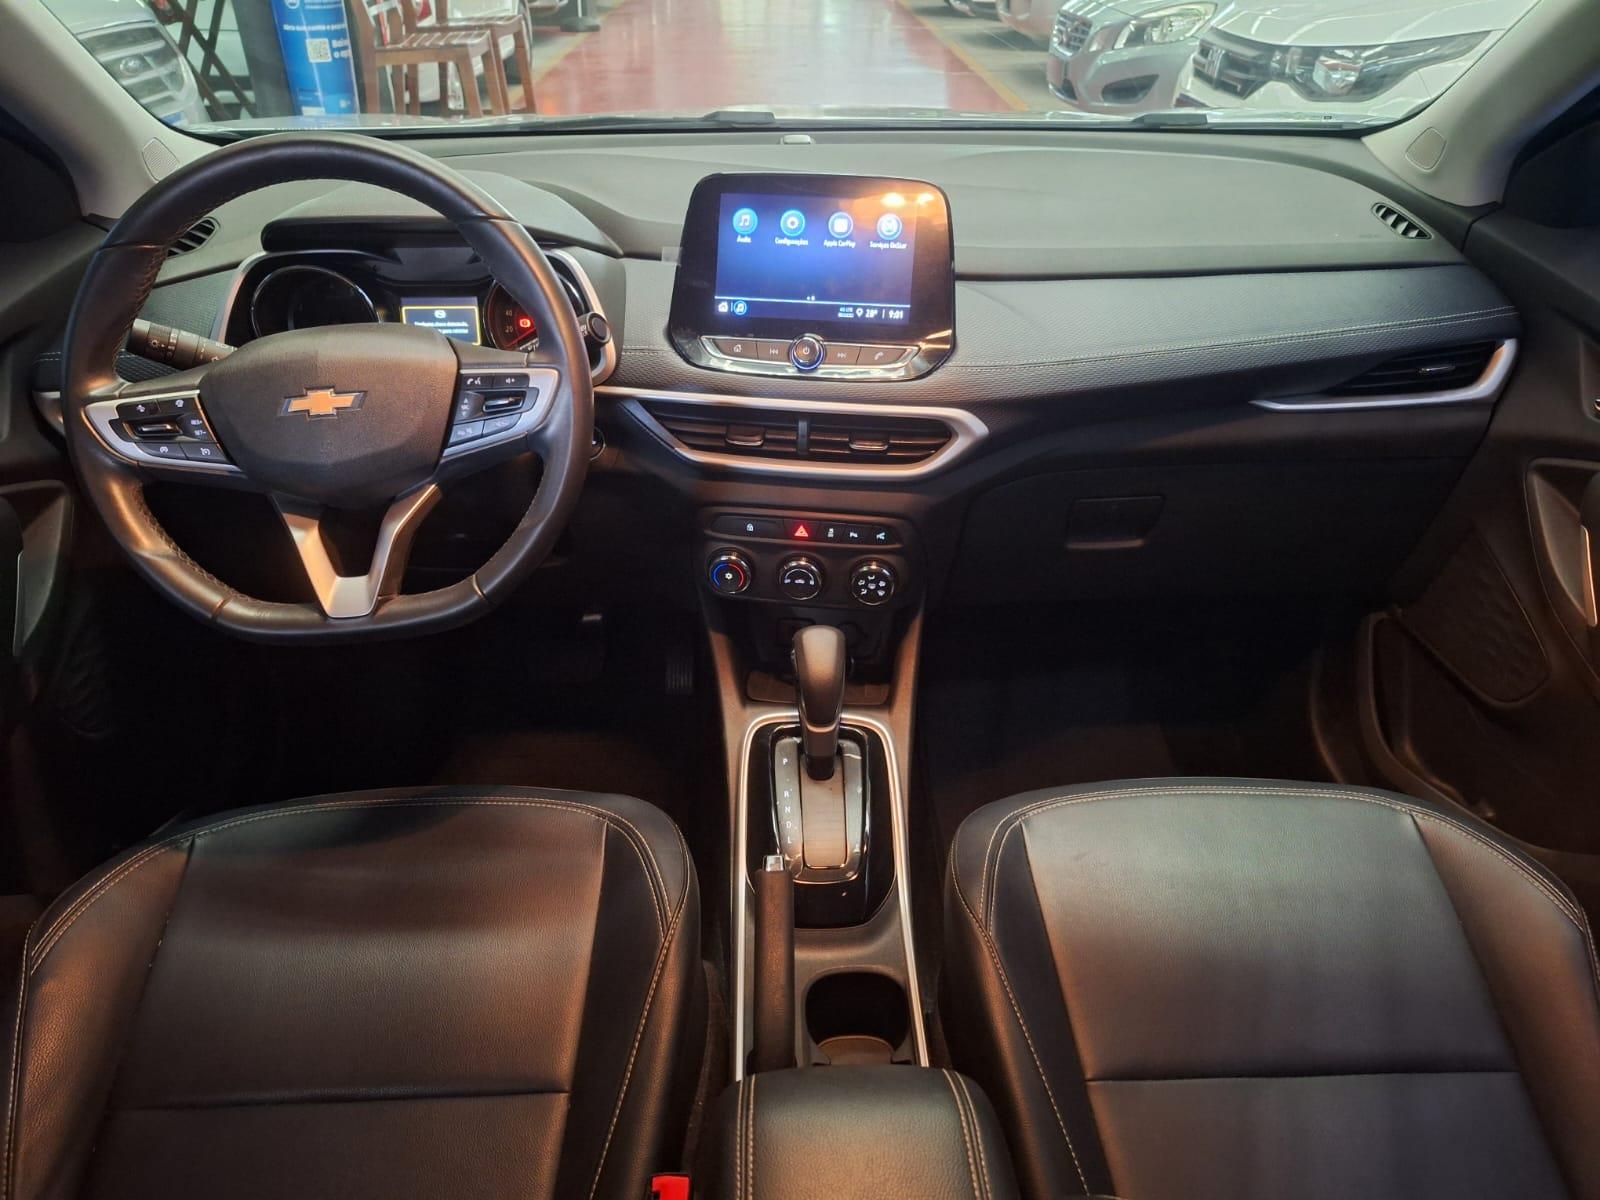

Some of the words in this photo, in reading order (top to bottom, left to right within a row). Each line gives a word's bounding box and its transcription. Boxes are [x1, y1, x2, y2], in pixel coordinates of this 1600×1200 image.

[782, 757, 788, 765] P
[784, 790, 790, 798] R
[786, 821, 792, 829] D
[787, 836, 792, 844] L
